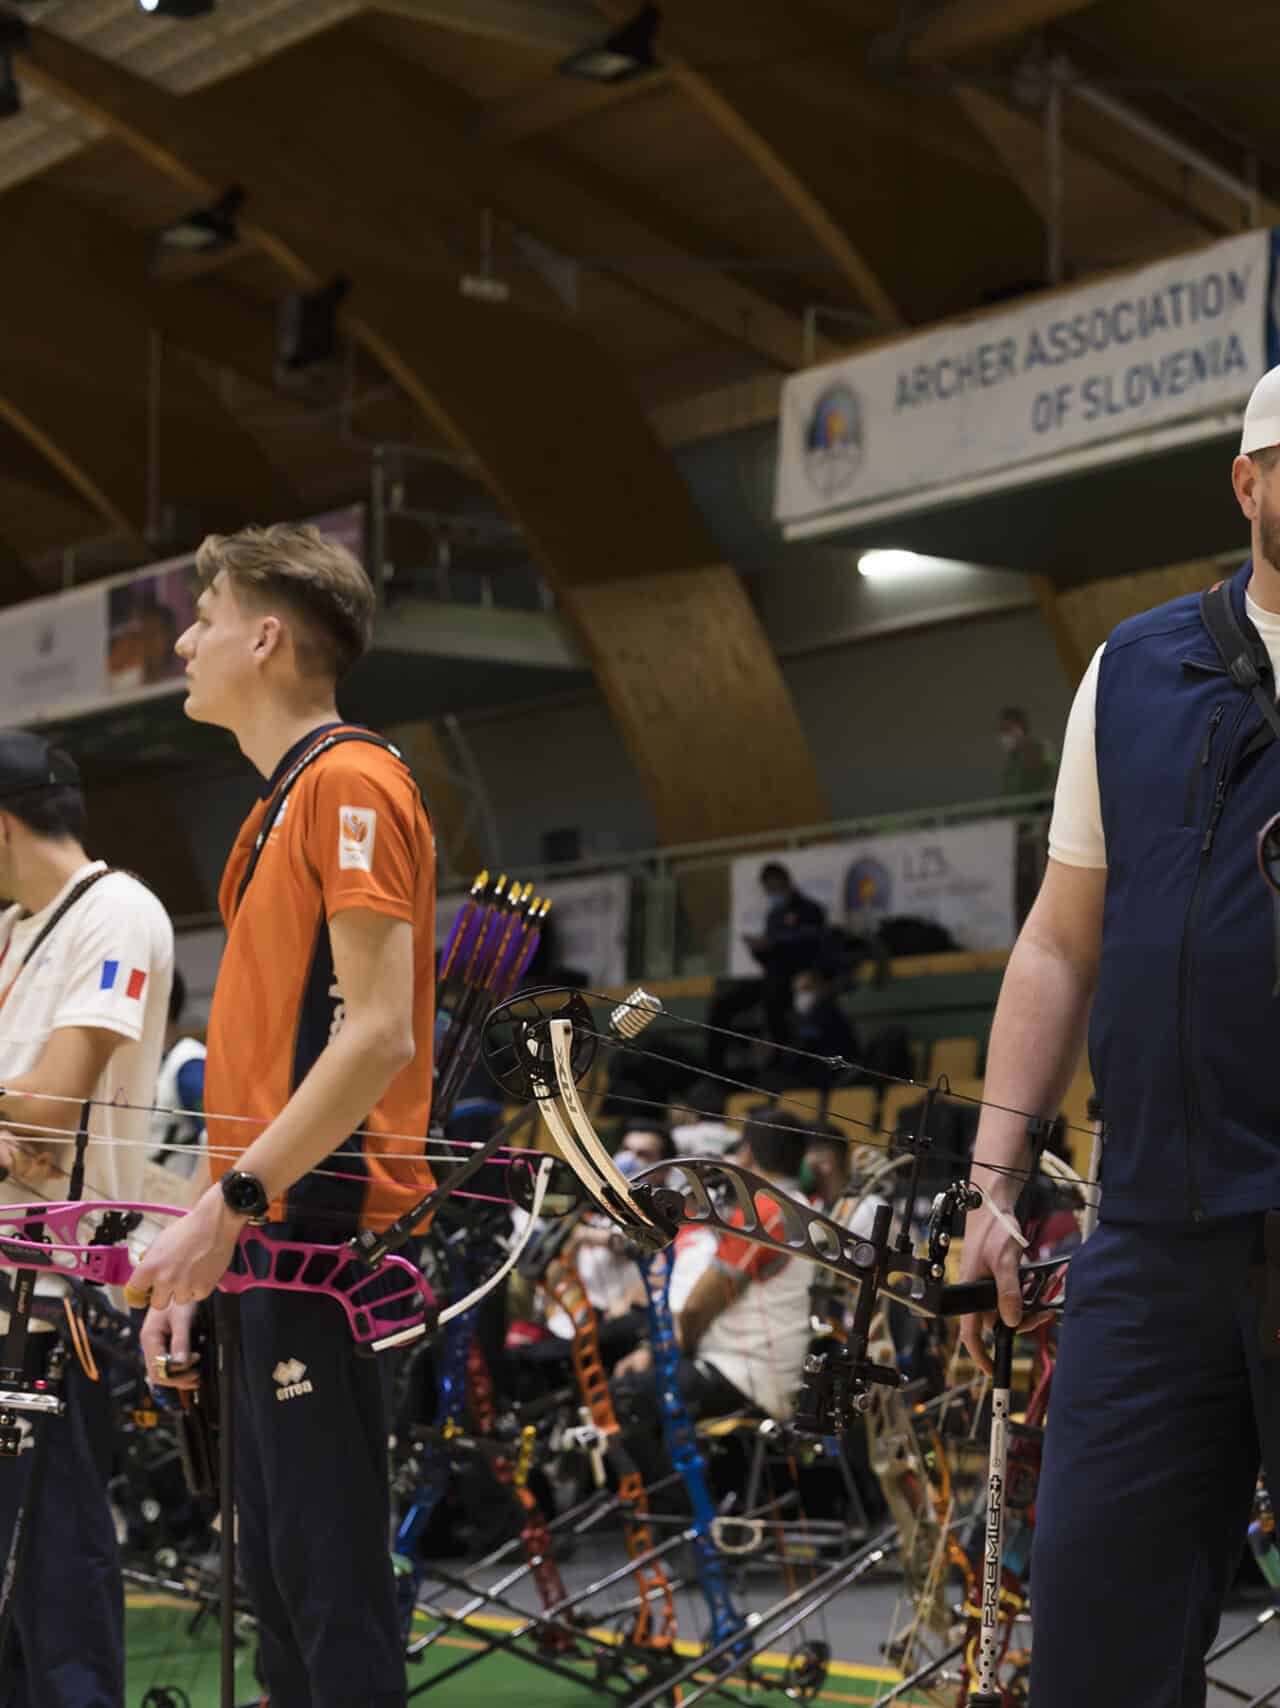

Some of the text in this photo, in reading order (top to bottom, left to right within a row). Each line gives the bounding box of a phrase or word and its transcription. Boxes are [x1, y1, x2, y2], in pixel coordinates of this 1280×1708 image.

[894, 264, 1252, 409] ARCHER ASSOCIATION
[1032, 335, 1248, 435] OF SLOVENIA
